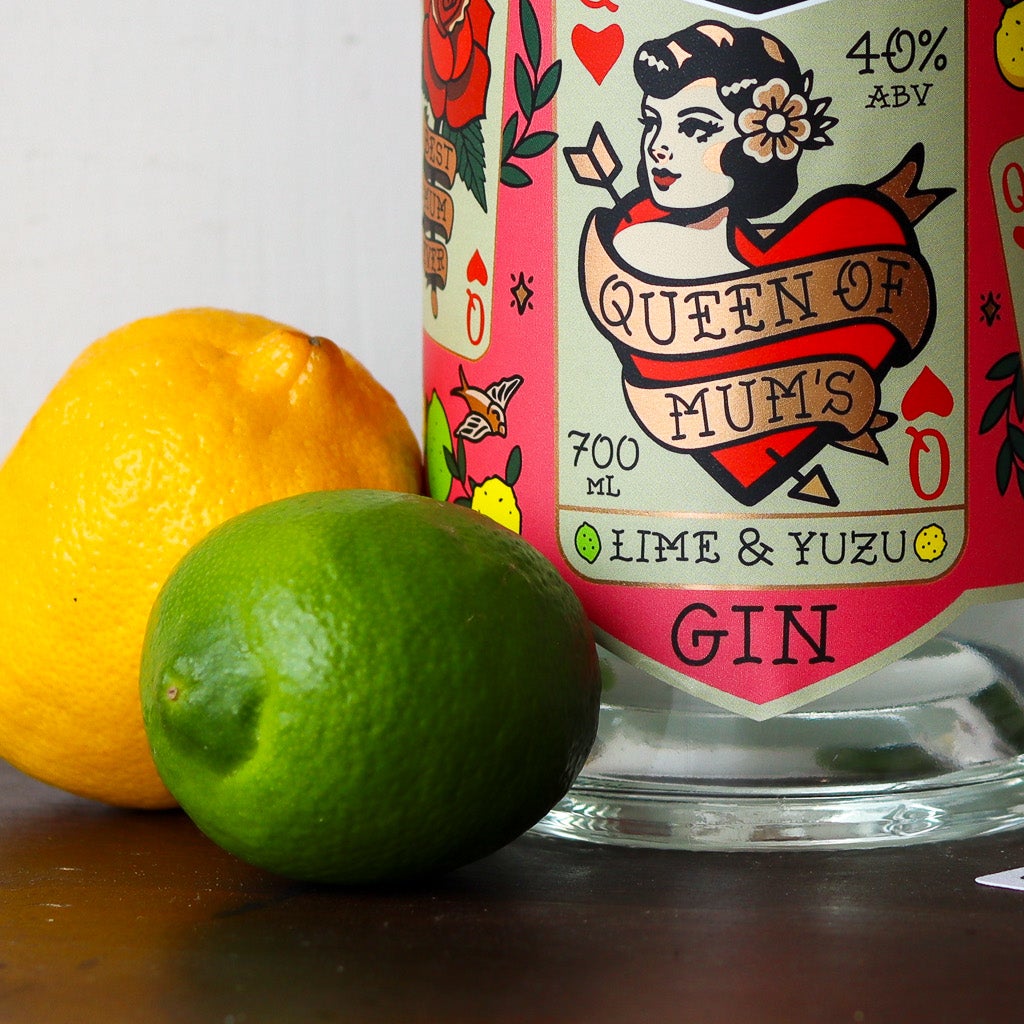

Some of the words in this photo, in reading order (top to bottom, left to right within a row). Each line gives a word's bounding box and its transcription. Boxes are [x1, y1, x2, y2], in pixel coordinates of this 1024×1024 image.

[845, 26, 948, 75] 40%
[864, 83, 934, 109] ABV
[466, 287, 485, 346] Q
[599, 271, 819, 346] QUEEN
[832, 255, 912, 314] OF
[665, 368, 857, 441] MUM'S
[568, 429, 640, 471] 700
[904, 425, 951, 502] Q
[586, 475, 621, 498] ML
[609, 528, 720, 564] LIME
[736, 527, 774, 566] &
[788, 529, 907, 566] YUZU
[670, 602, 838, 667] GIN
